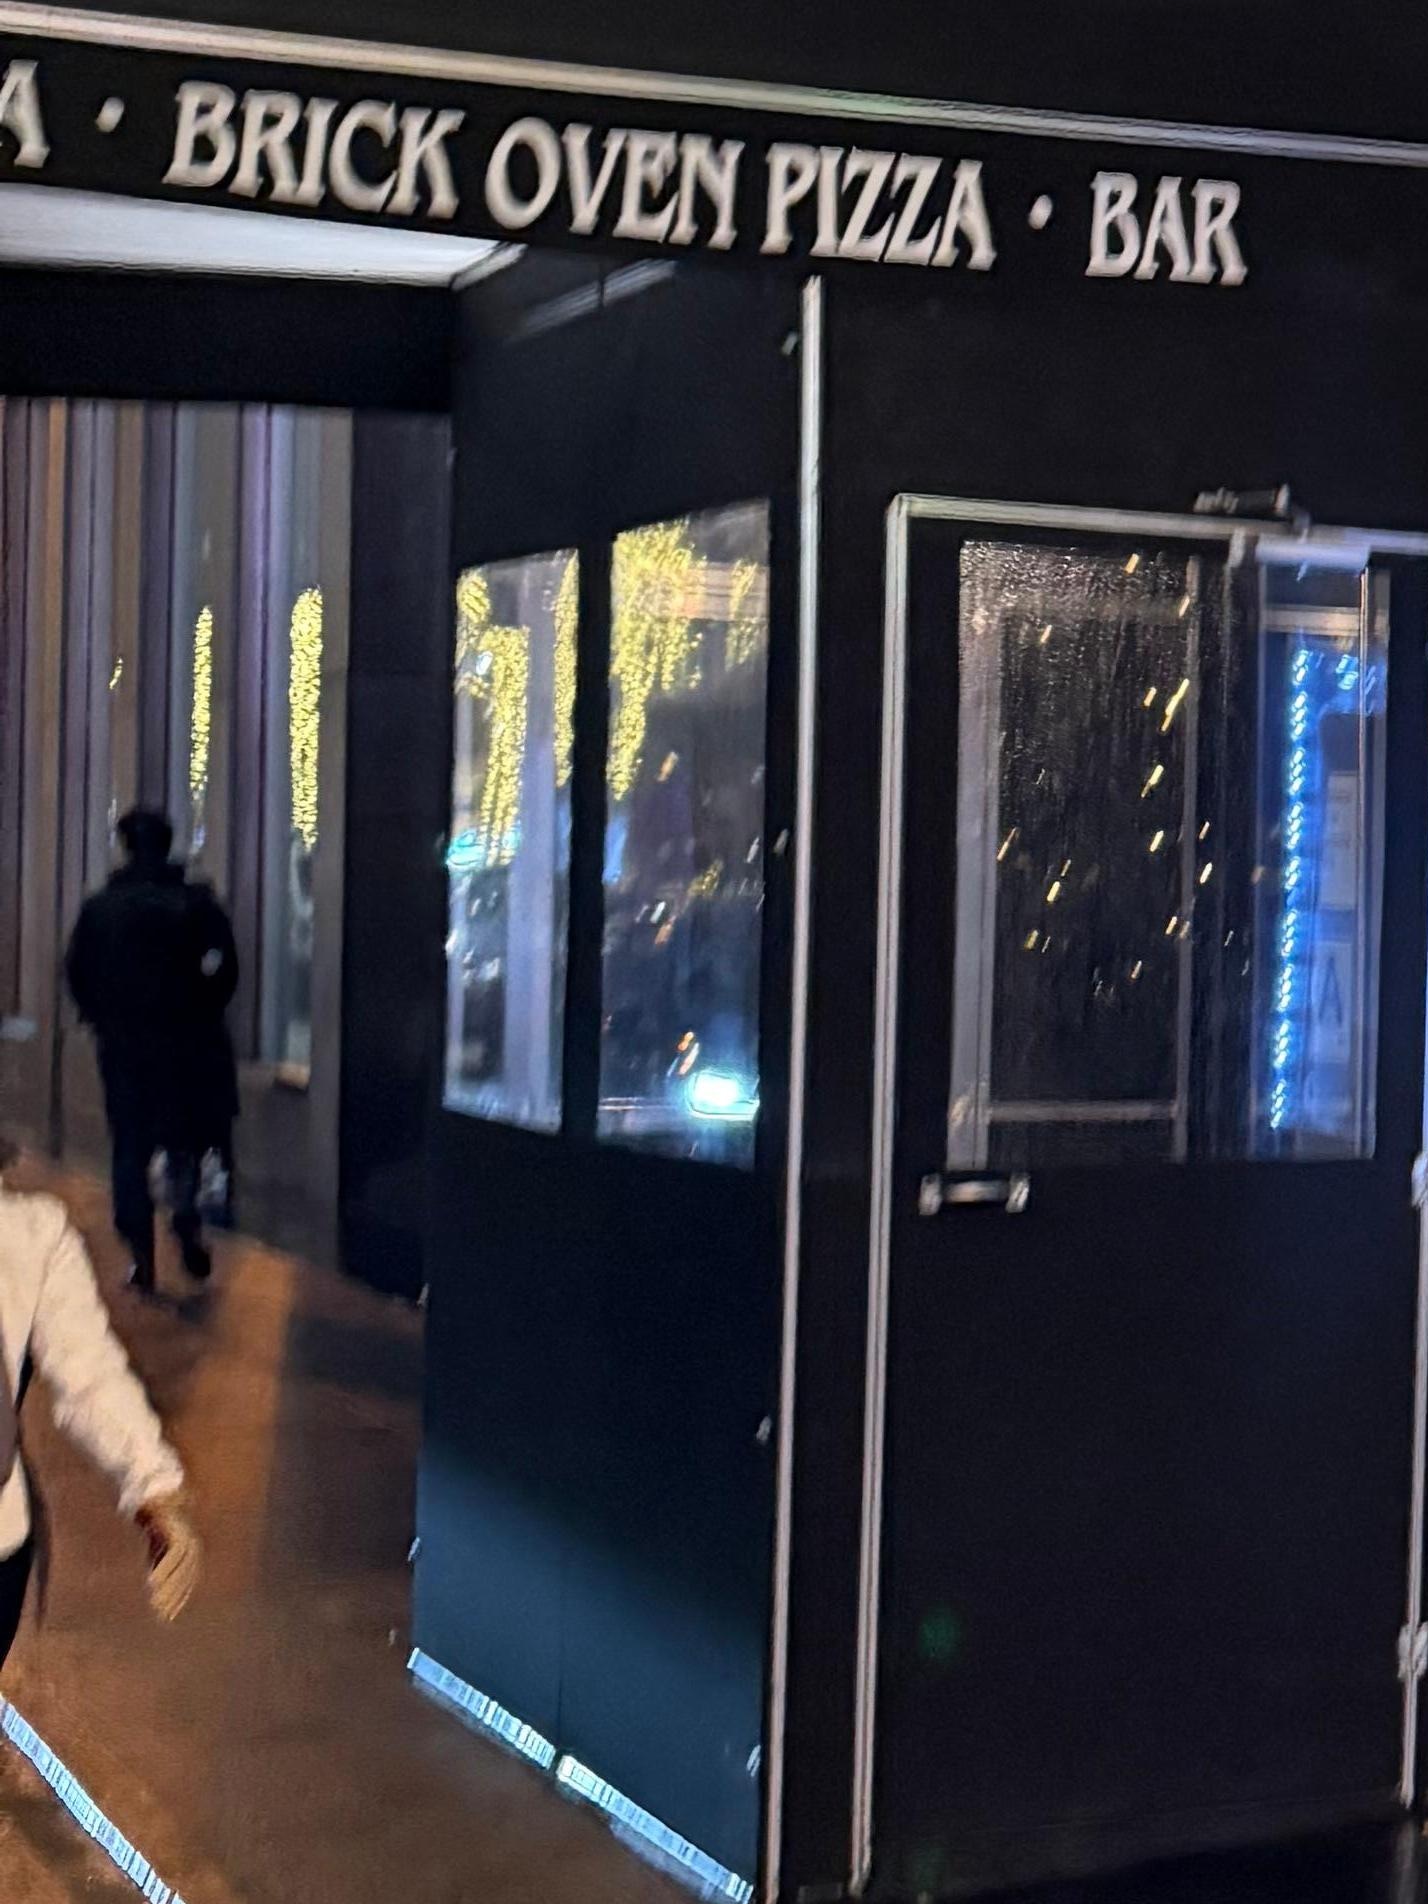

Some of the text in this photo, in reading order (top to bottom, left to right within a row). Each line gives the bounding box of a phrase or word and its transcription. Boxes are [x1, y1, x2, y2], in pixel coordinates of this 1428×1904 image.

[161, 79, 467, 220] BRICK
[484, 115, 747, 252] OVEN
[759, 140, 999, 272] PIZZA
[1084, 170, 1250, 286] BAR
